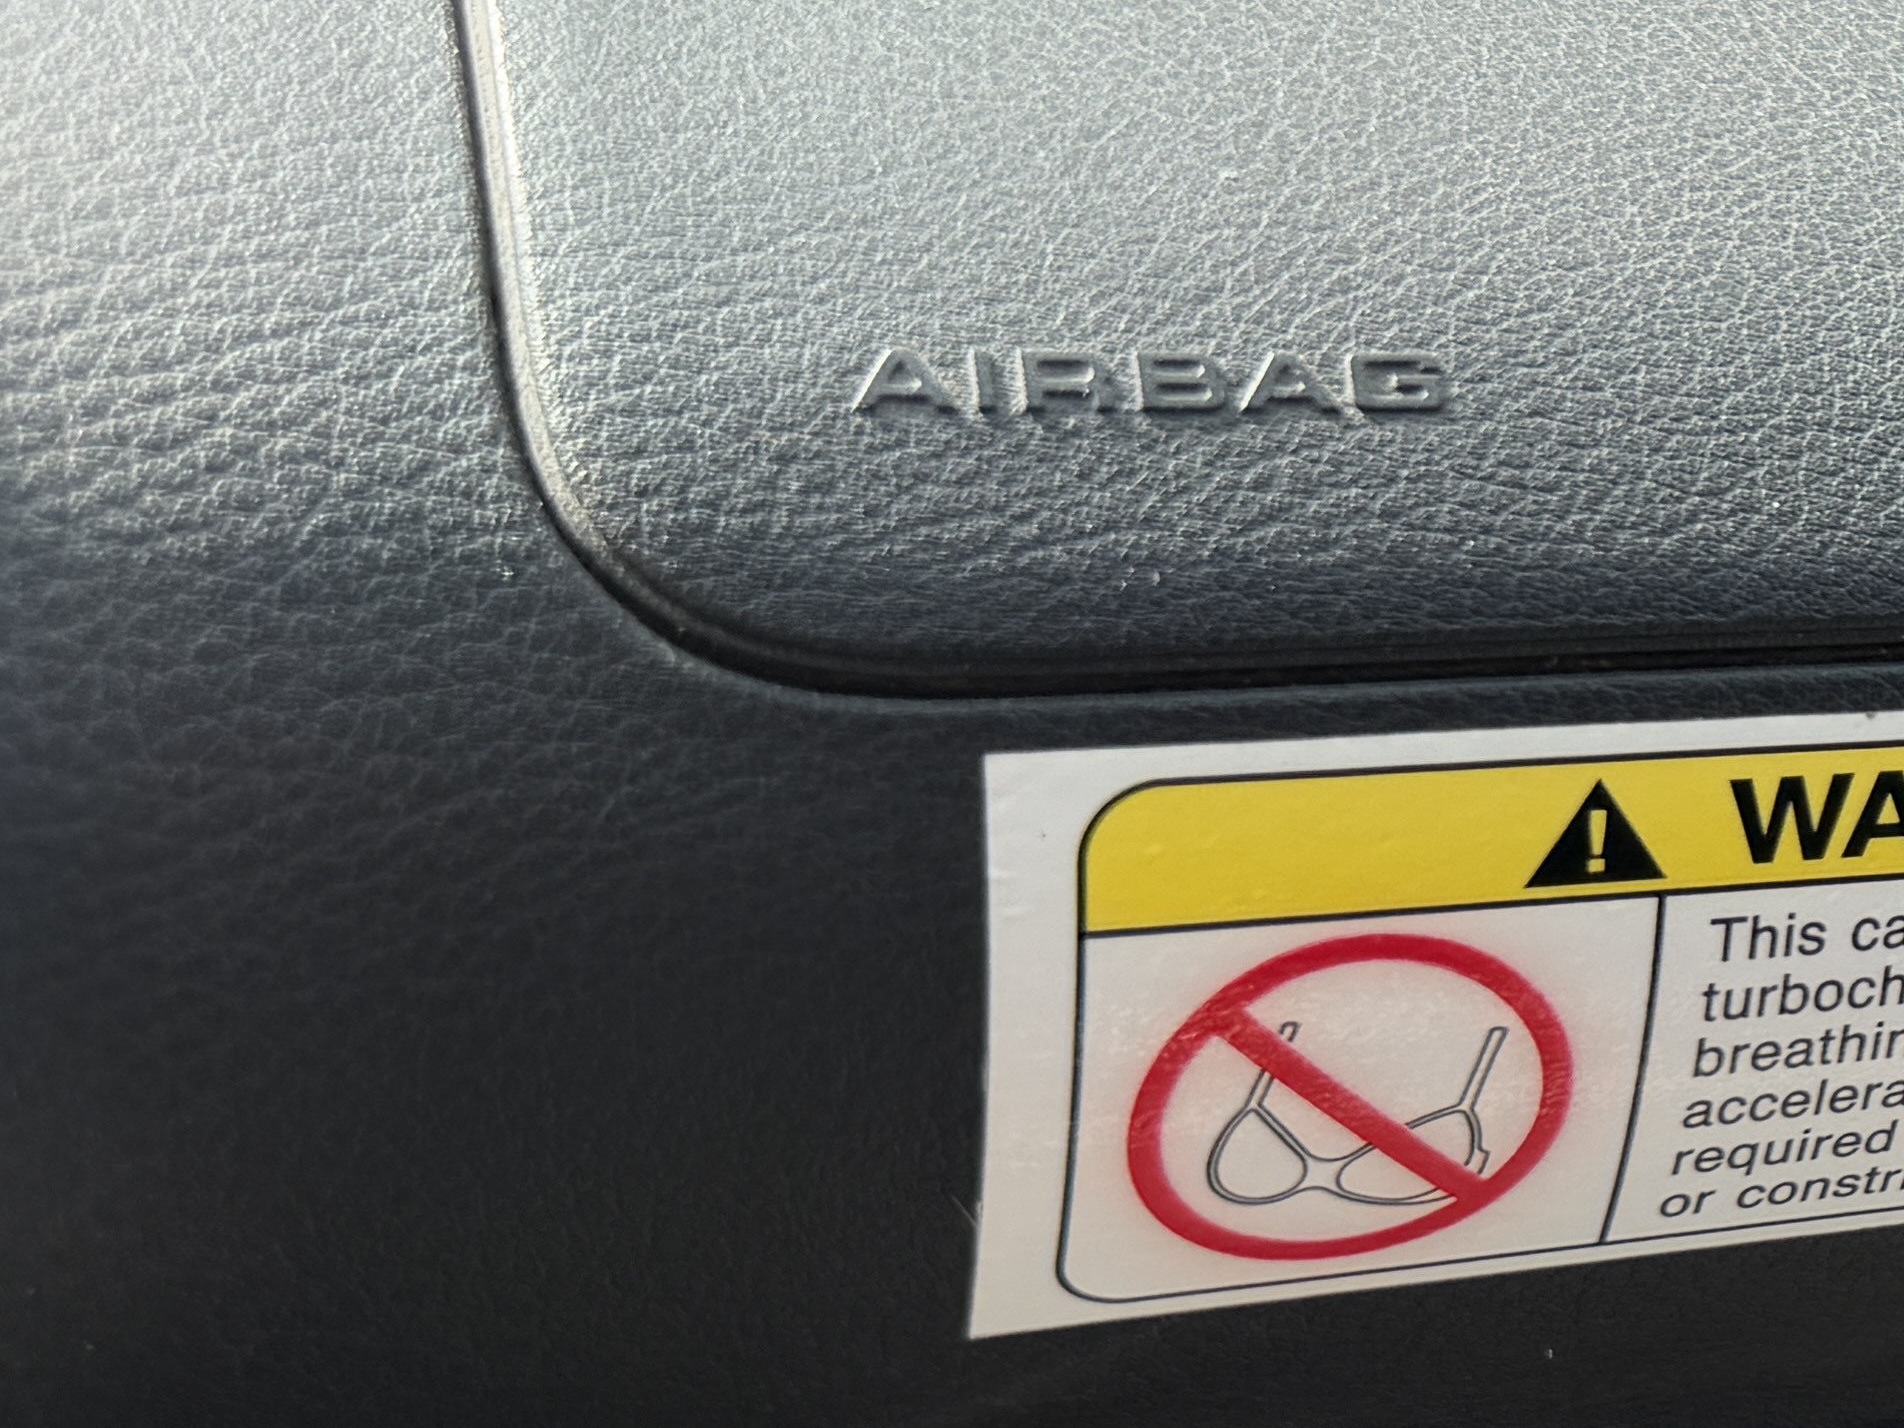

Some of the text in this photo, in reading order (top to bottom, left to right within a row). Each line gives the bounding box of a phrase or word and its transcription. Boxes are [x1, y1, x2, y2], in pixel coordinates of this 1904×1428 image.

[853, 347, 1453, 415] AIRBAG
[1708, 911, 1828, 964] This
[1669, 1117, 1900, 1178] required
[1657, 1188, 1718, 1219] or
